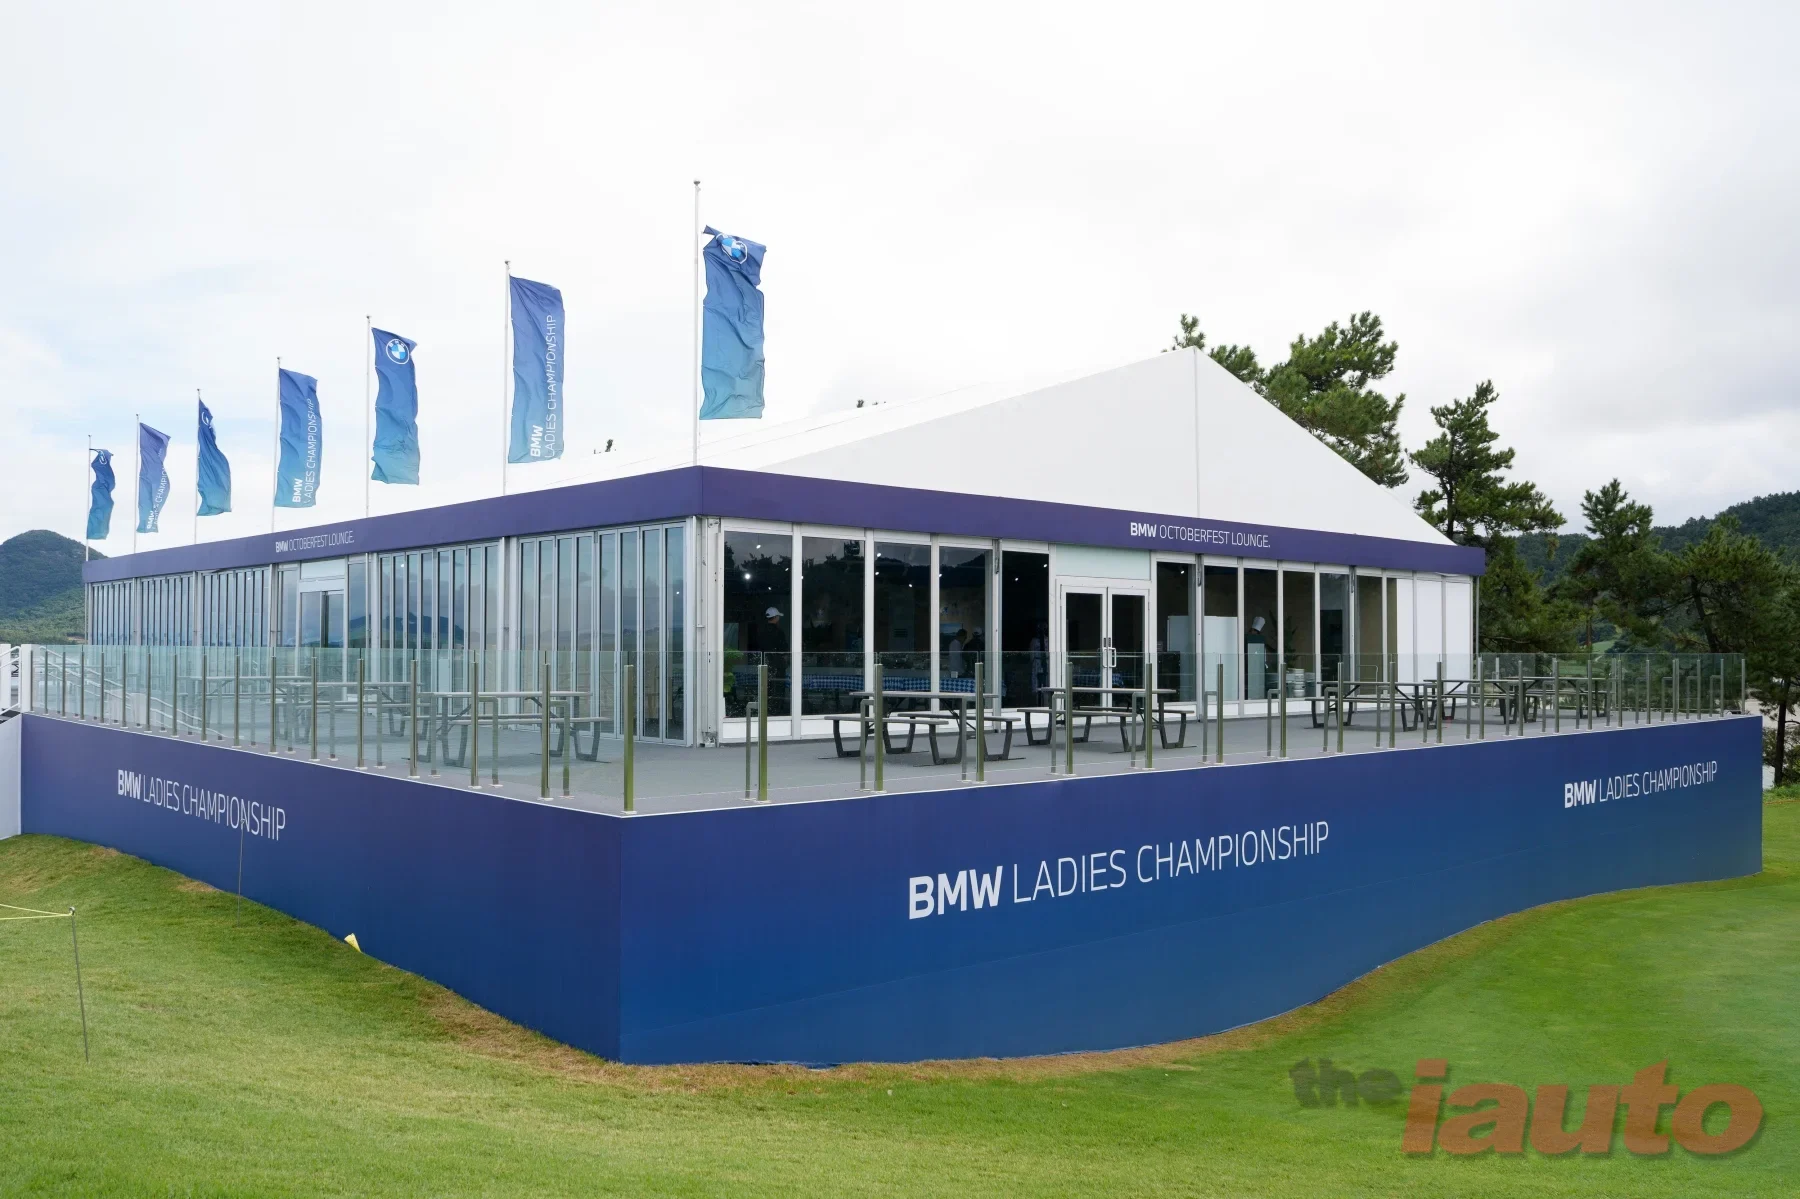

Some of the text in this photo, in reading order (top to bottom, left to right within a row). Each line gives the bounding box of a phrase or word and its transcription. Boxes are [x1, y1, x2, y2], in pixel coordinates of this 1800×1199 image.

[545, 315, 557, 458] LADIES CHAMPIONSHIP
[307, 398, 317, 468] CHAMPIONSHIP
[531, 425, 543, 457] BMW
[292, 478, 303, 503] BMW
[275, 540, 288, 553] BMW
[288, 534, 328, 551] OCTOBERFEST
[1130, 522, 1157, 538] BMW
[1159, 524, 1230, 545] OCTOBERFEST
[118, 769, 286, 841] BMW LADIES CHAMPIONSHIP
[1564, 760, 1718, 809] BMW LADIES CHAMPIONSHIP
[908, 821, 1329, 920] BMW LADIES CHAMPIONSHIP
